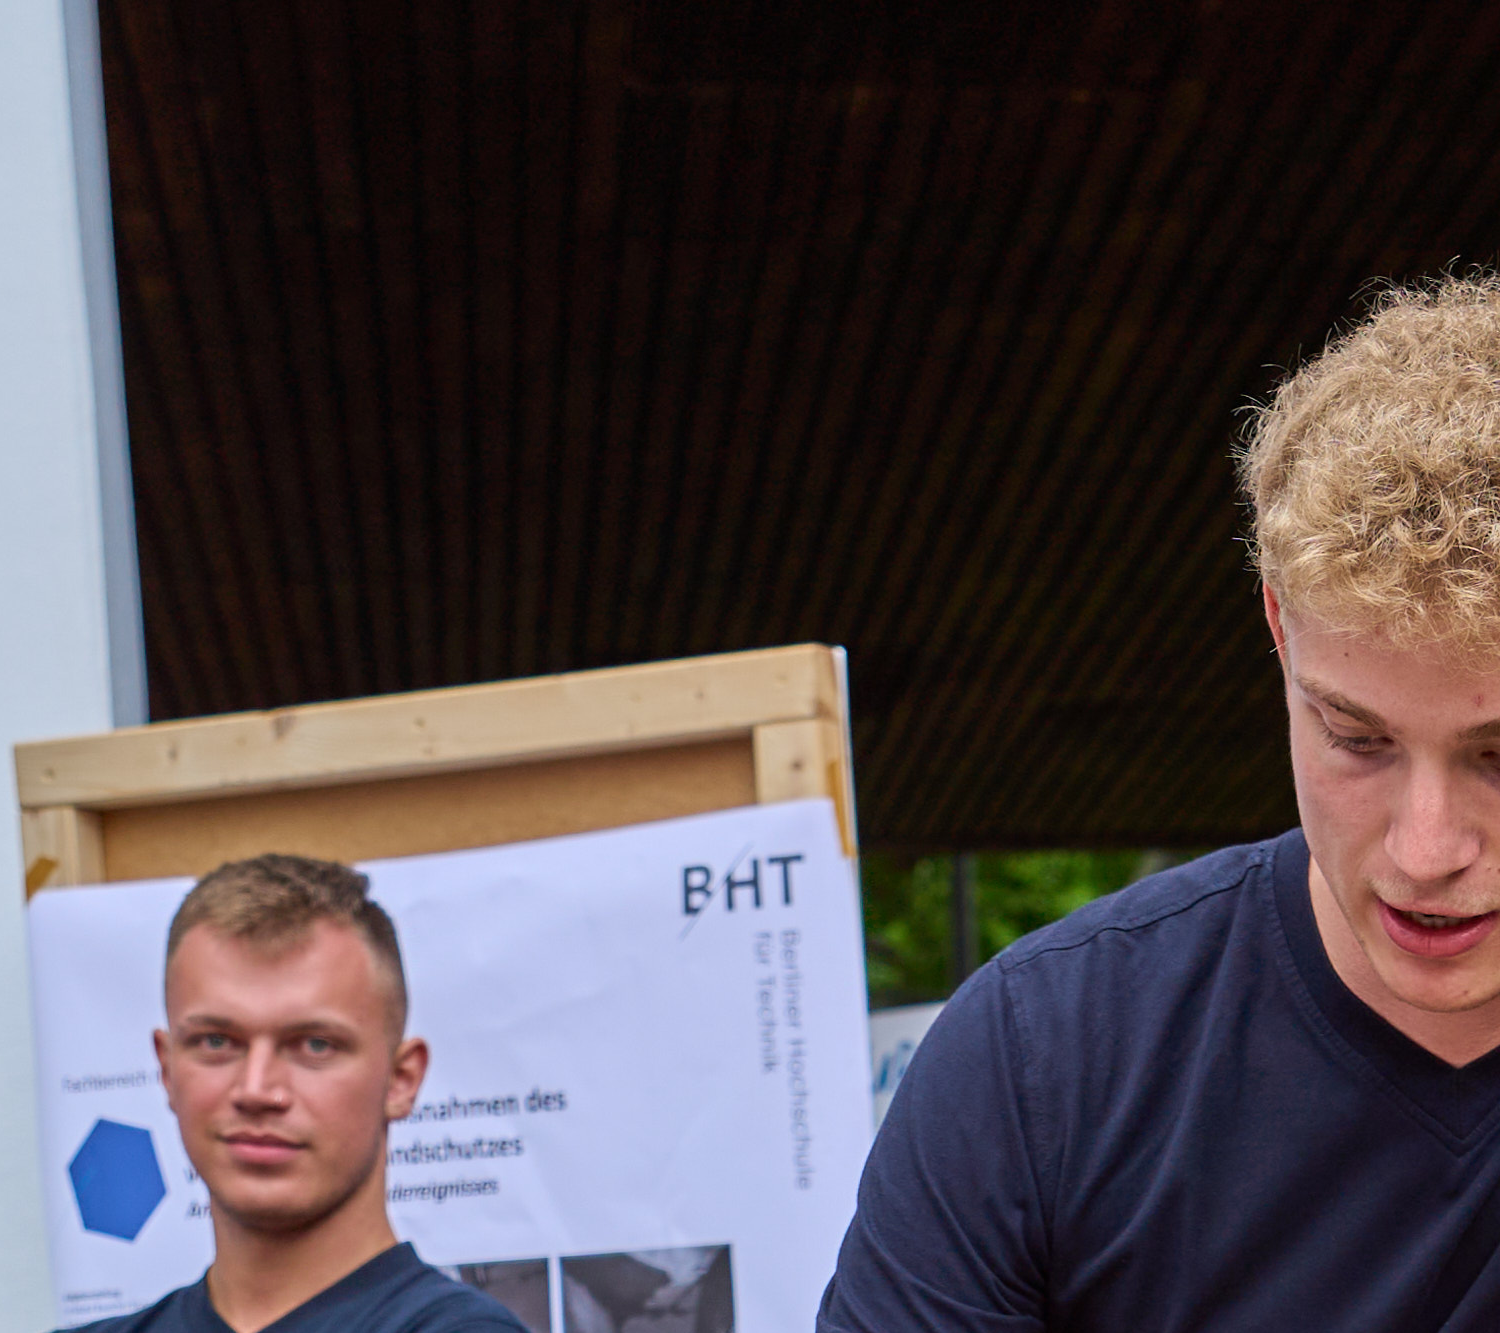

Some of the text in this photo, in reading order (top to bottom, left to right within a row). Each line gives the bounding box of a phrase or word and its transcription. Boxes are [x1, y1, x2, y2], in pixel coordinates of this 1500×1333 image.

[683, 854, 804, 915] BHT
[753, 930, 778, 1074] für Technik
[780, 929, 815, 1191] Berliner Hochschule
[526, 1087, 568, 1113] des
[388, 1137, 525, 1166] ndschutzes
